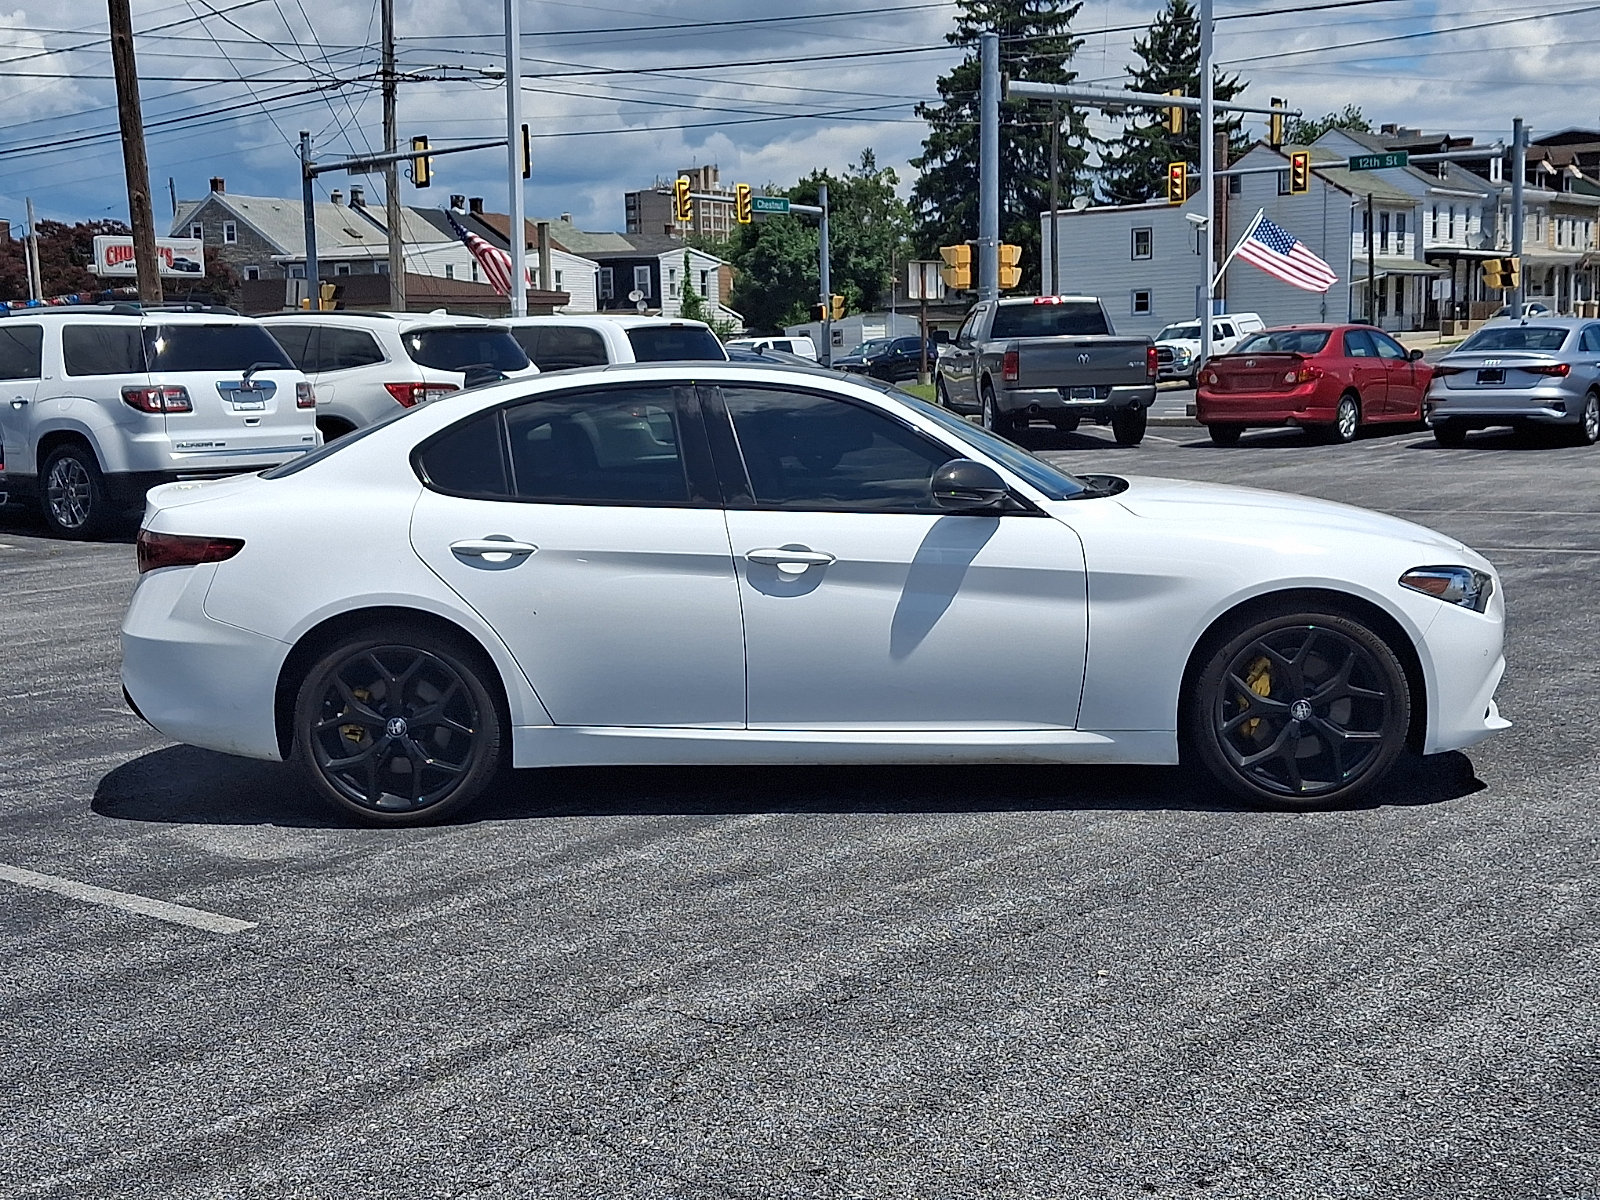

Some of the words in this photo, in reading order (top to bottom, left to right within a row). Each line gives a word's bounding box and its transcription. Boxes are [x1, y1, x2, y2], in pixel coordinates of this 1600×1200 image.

[1359, 157, 1380, 168] 12th
[1386, 155, 1398, 166] St
[756, 199, 784, 210] Chestnut
